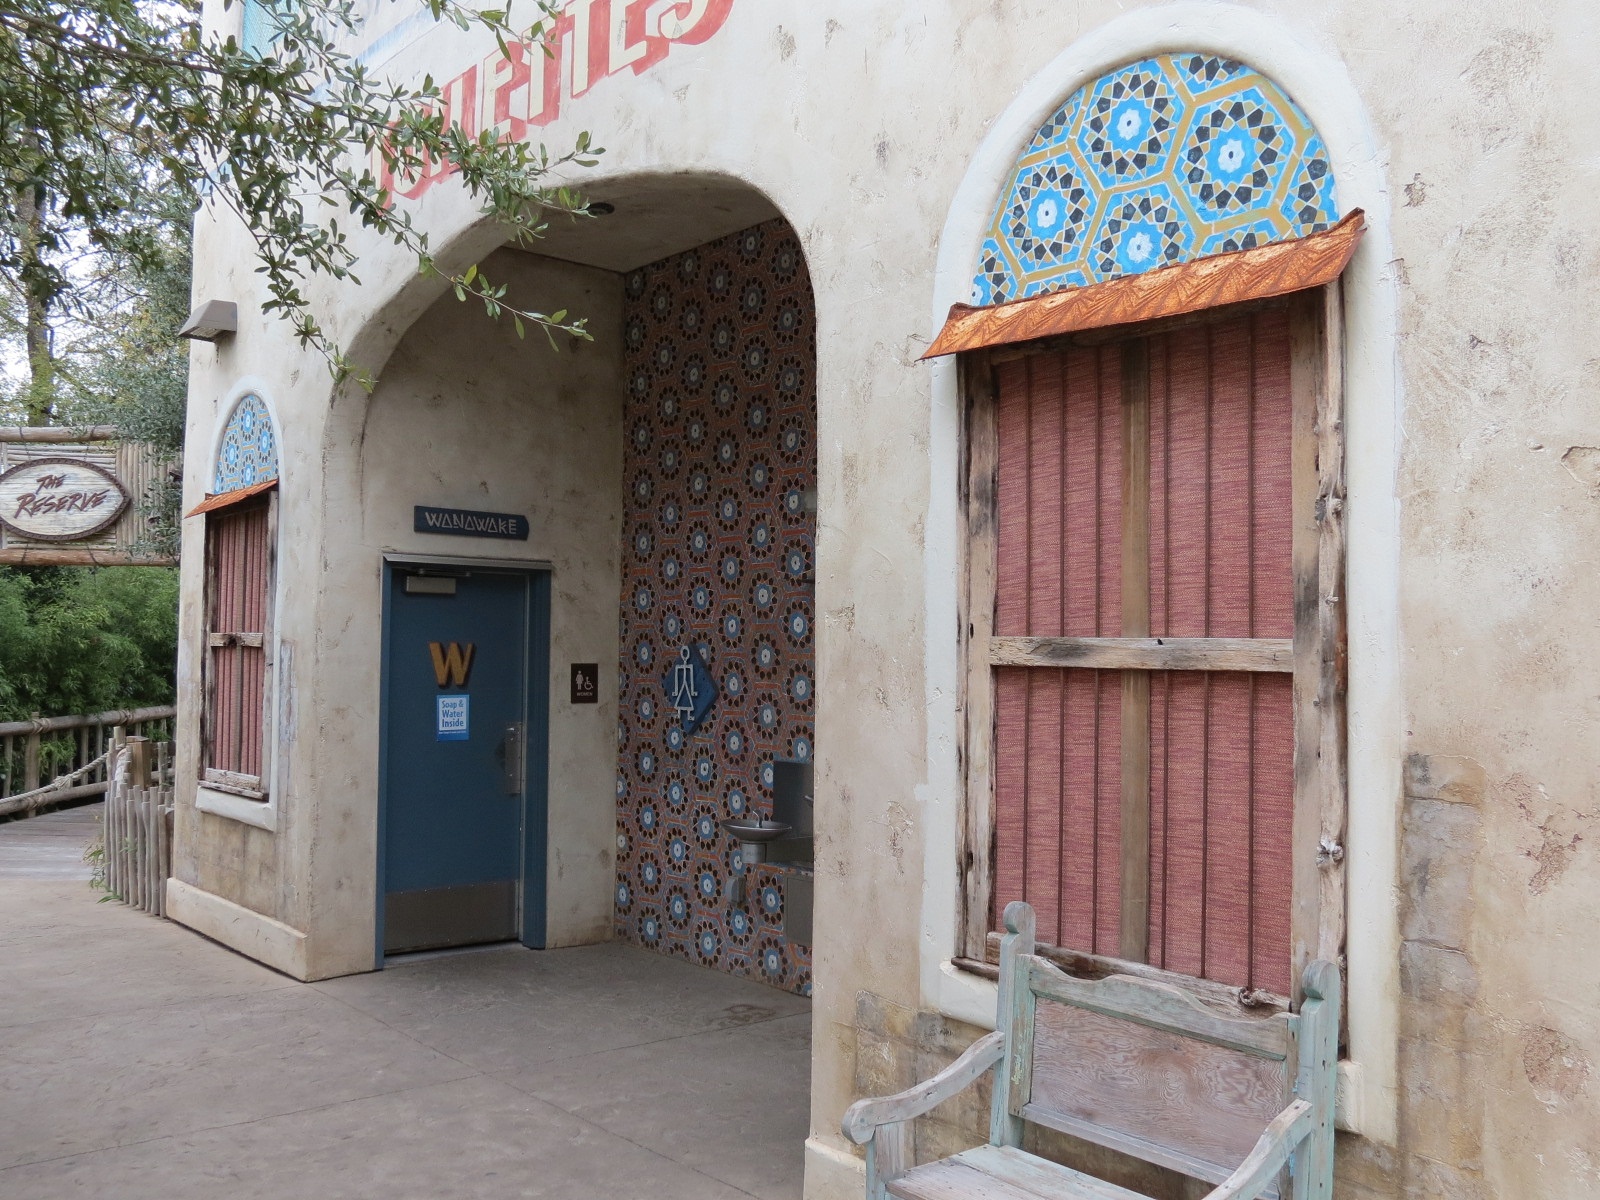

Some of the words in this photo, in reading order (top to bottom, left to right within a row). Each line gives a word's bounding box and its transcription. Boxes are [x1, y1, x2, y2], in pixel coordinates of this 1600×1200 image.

[36, 474, 67, 495] THE
[13, 489, 110, 519] RESERVE
[425, 511, 517, 535] WANAWAKE
[429, 641, 474, 686] W
[441, 700, 457, 709] Soap
[458, 699, 464, 707] &
[442, 709, 463, 718] Water
[442, 718, 464, 727] Inside
